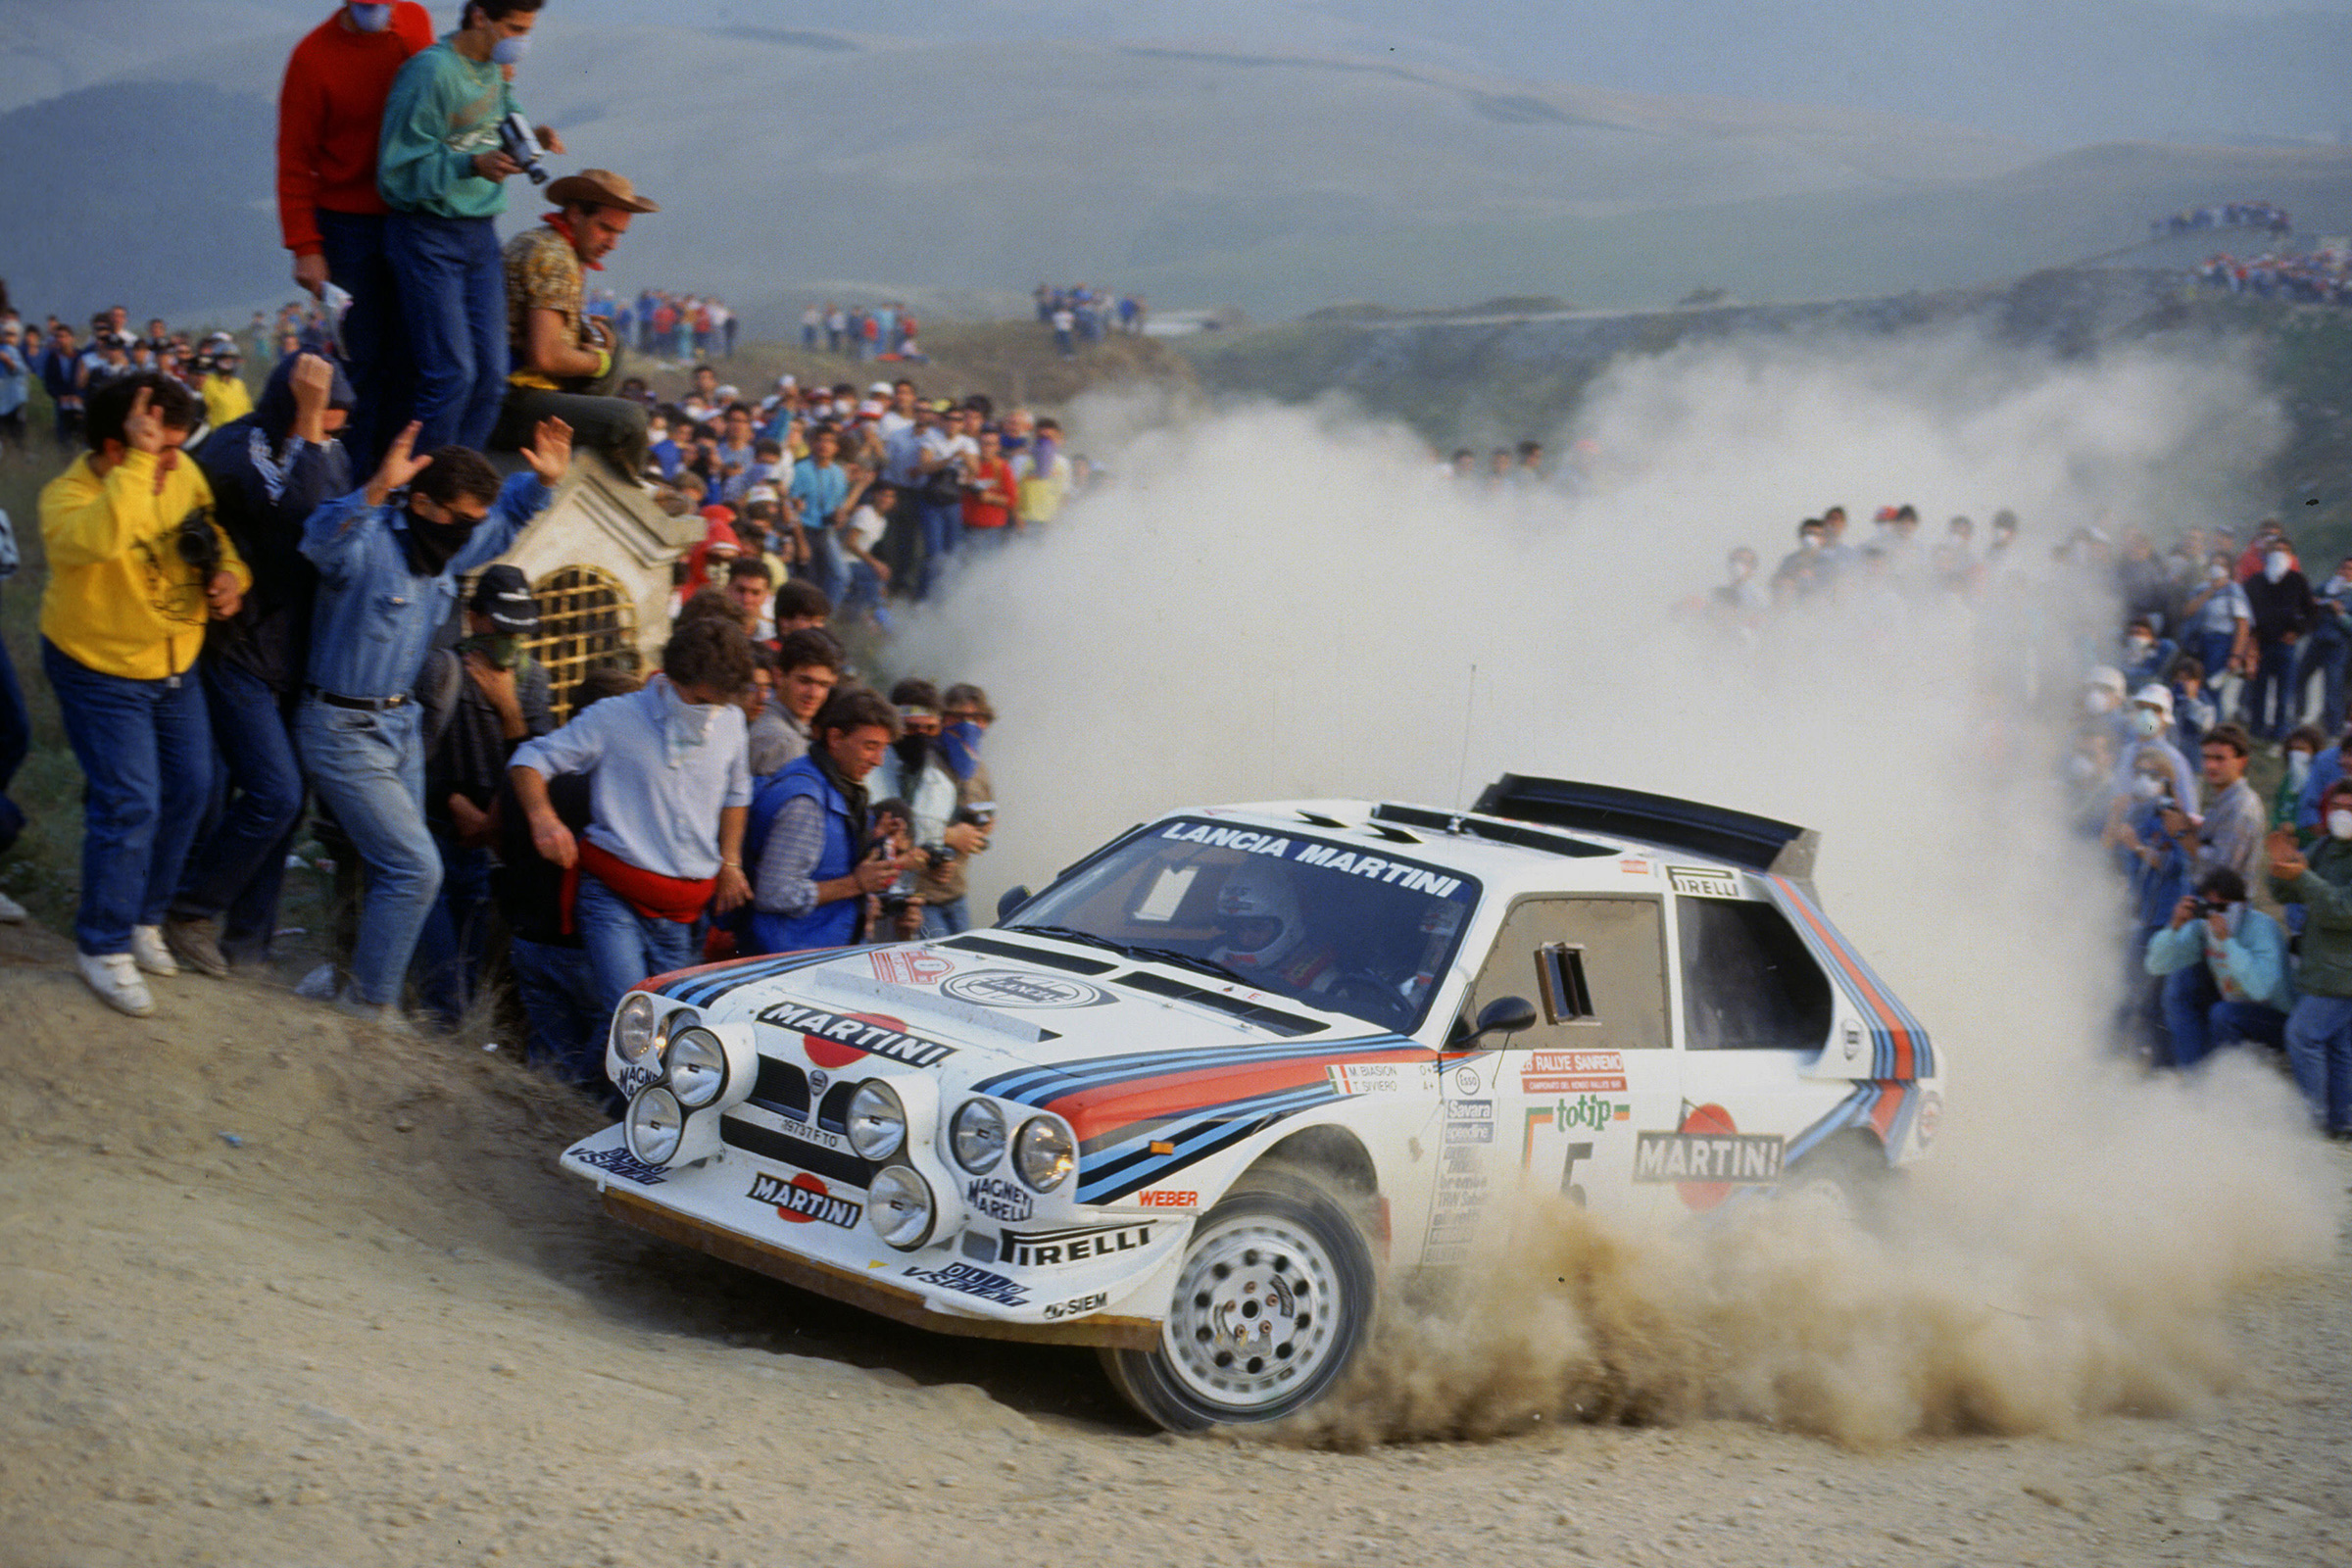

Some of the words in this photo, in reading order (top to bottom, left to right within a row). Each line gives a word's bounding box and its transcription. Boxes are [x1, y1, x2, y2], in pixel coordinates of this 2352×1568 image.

[1161, 821, 1292, 857] LANCIA
[1295, 844, 1461, 898] MARTINI
[1665, 864, 1740, 897] PIRELLI
[763, 1004, 948, 1064] MARTINI
[1574, 1054, 1623, 1071] SANREMO
[1449, 1100, 1491, 1117] Savara
[1556, 1094, 1611, 1132] totip
[1638, 1138, 1780, 1177] MARTINI
[753, 1177, 858, 1227] MARTINI
[1139, 1191, 1198, 1206] WEBER
[999, 1219, 1157, 1266] PIRELLI
[945, 1264, 1026, 1294] OLIO
[1068, 1292, 1108, 1314] SIEM
